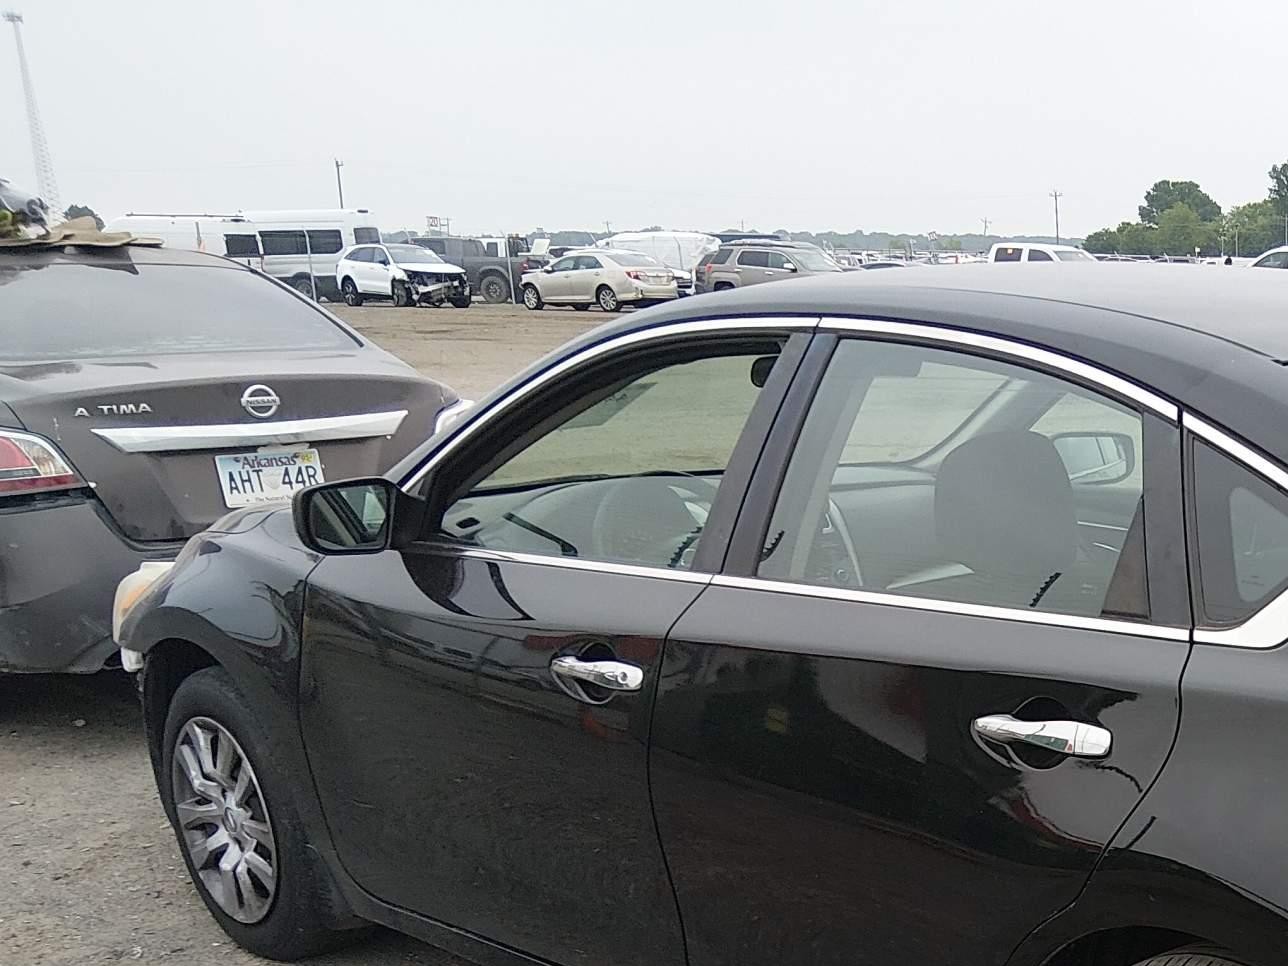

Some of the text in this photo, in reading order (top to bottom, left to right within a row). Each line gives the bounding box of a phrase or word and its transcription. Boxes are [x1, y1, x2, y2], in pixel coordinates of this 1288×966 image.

[241, 456, 297, 469] Arkansas
[229, 465, 319, 494] AHT 44R
